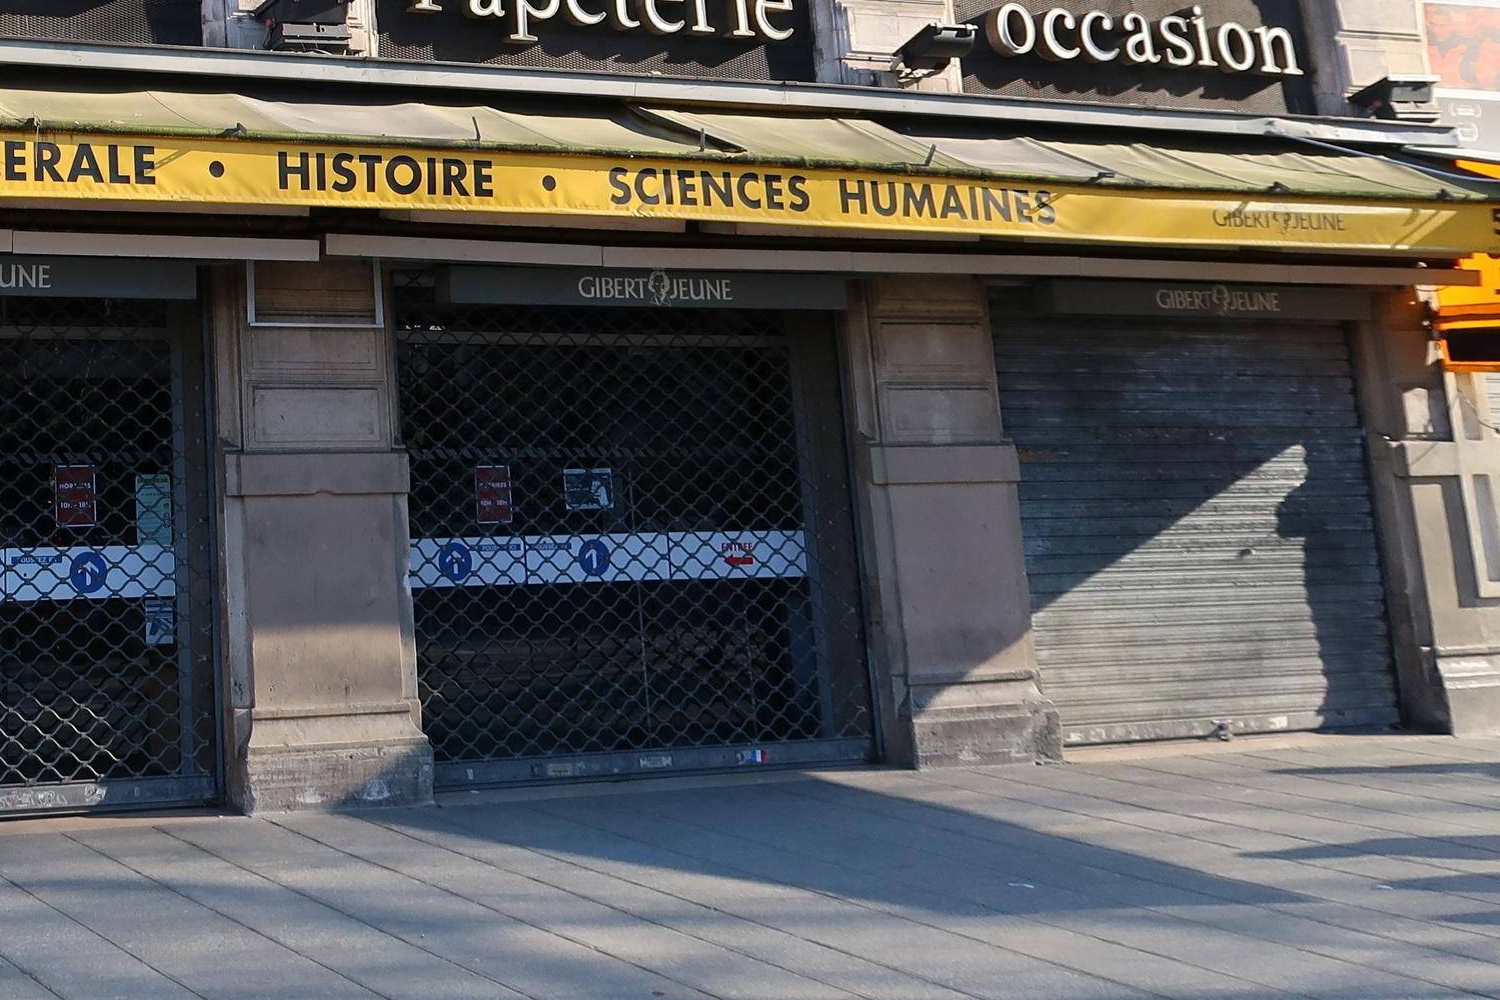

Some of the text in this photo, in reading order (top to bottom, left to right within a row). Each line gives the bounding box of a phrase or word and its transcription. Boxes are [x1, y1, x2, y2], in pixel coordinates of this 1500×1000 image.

[993, 2, 1304, 76] occasion
[277, 151, 494, 198] HISTOIRE
[609, 166, 810, 212] SCIENCES
[840, 178, 1057, 225] HUMAINES
[1212, 208, 1346, 231] GIBERT JEUNE
[578, 276, 733, 301] GIBERT JEUNE
[1155, 289, 1281, 312] GIBERT JEUNE
